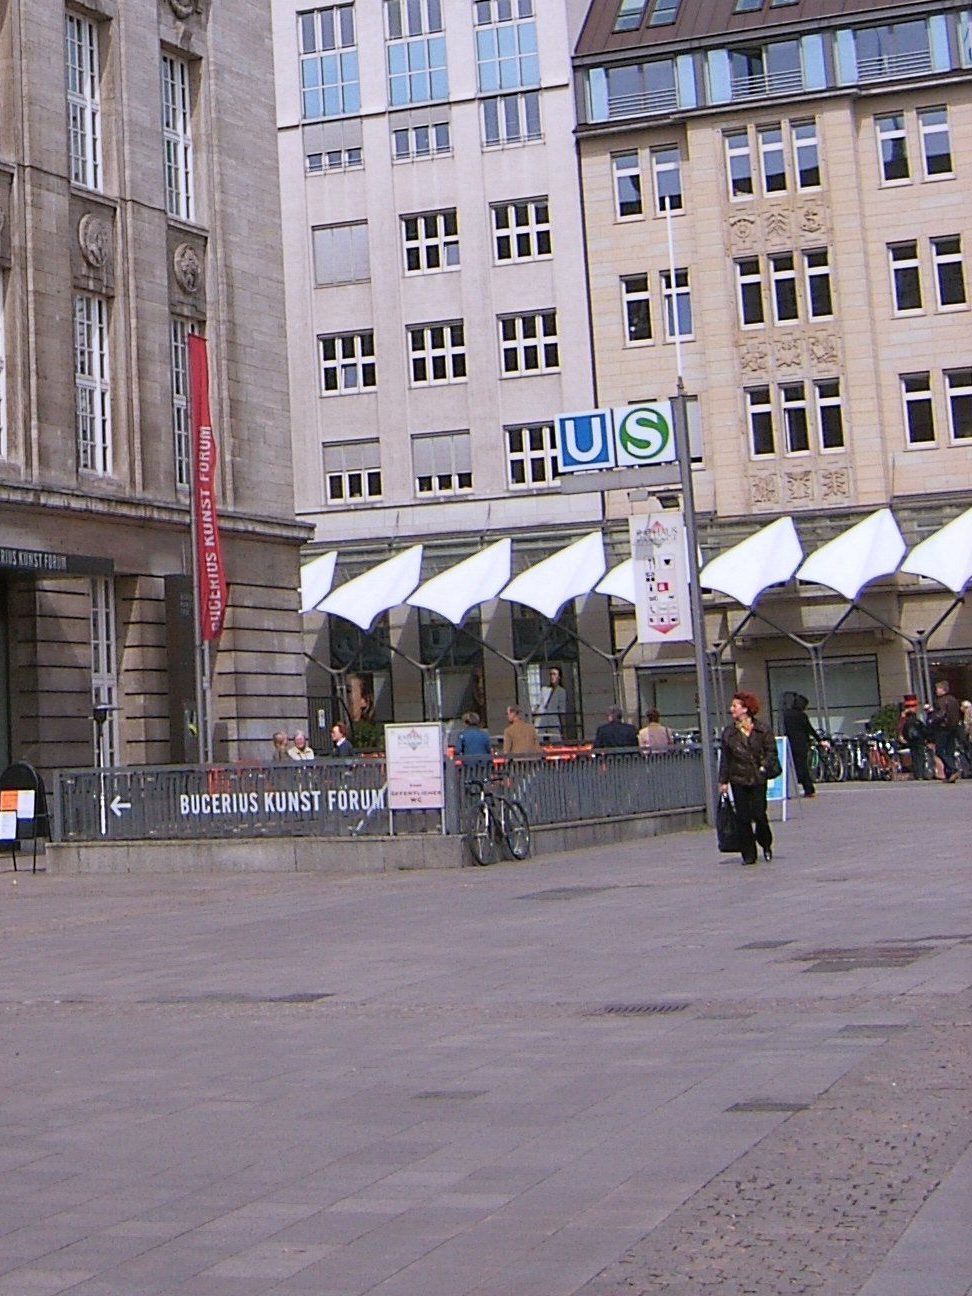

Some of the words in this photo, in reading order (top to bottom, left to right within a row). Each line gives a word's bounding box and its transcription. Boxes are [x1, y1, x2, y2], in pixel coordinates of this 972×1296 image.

[199, 426, 211, 481] FORUM
[565, 417, 602, 462] U
[625, 411, 662, 456] S
[200, 488, 215, 546] KUNST
[18, 551, 42, 567] KUNST
[44, 554, 67, 570] FORUM
[180, 792, 259, 815] BUCERIUS
[264, 790, 321, 813] KUNST
[328, 789, 385, 811] FORUM
